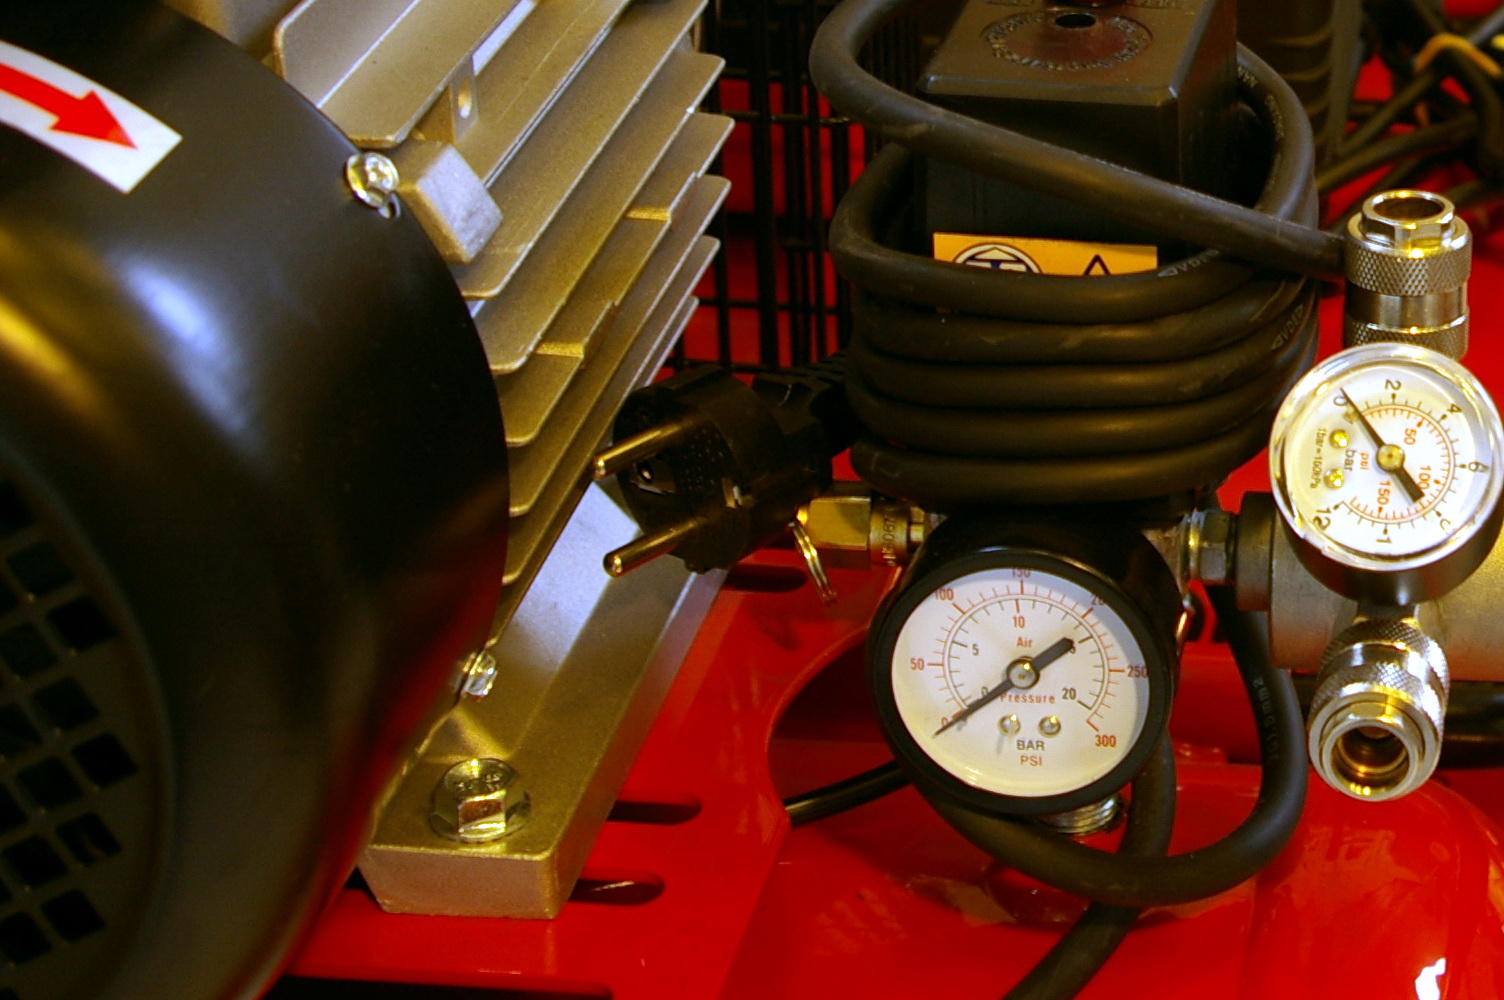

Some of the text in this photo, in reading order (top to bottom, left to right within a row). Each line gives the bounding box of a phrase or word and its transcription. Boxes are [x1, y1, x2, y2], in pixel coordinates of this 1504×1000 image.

[1384, 379, 1402, 391] 2
[1333, 396, 1348, 407] 0
[1447, 403, 1463, 413] 4
[1403, 428, 1417, 445] 50
[1344, 449, 1356, 471] bar
[1360, 452, 1370, 470] psi
[1418, 465, 1431, 490] 100
[1376, 480, 1391, 505] 150
[1313, 507, 1331, 531] 12
[935, 588, 955, 600] 100
[1013, 616, 1025, 628] 10
[1016, 637, 1033, 648] Air
[972, 644, 979, 656] 5
[910, 658, 924, 670] 50
[1127, 664, 1149, 679] 250
[1000, 693, 1056, 704] Pressure
[1061, 687, 1077, 700] 20
[1016, 739, 1046, 751] BAR
[1095, 735, 1117, 748] 300
[1019, 755, 1043, 767] PSI
